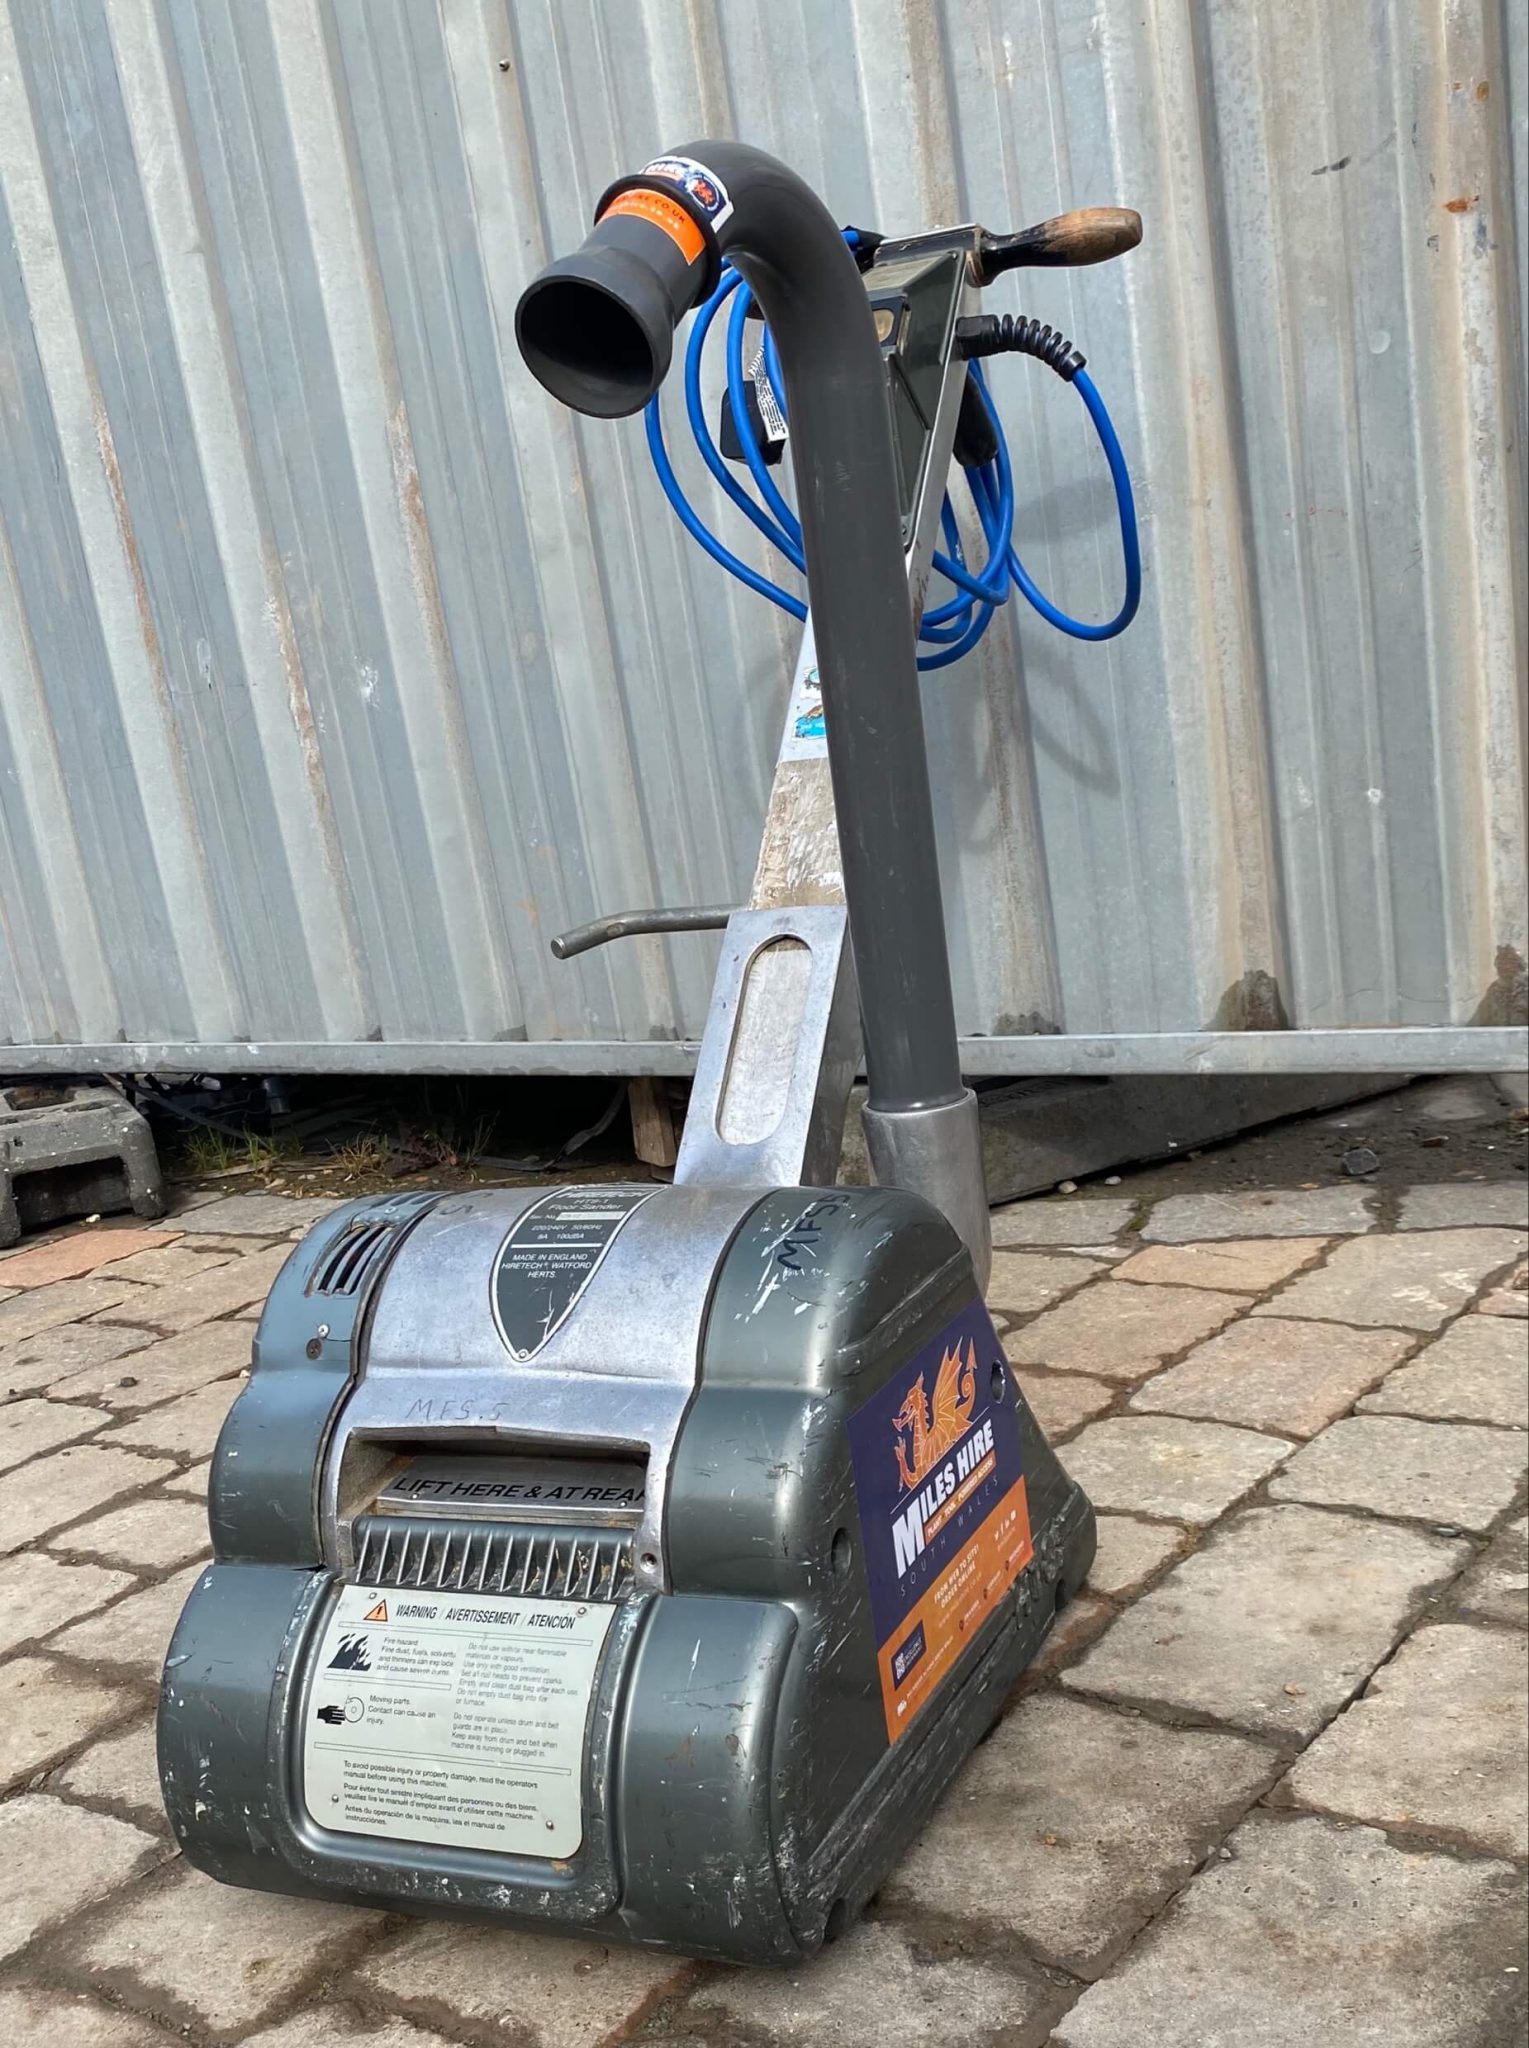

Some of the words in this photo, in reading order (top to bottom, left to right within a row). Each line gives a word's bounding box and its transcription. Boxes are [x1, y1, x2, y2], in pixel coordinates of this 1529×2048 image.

[393, 1478, 452, 1496] LIFT
[452, 1482, 524, 1498] HERE
[523, 1486, 544, 1498] &
[546, 1486, 586, 1500] AT
[892, 1462, 956, 1579] MILES
[956, 1419, 994, 1483] HIRE
[928, 1515, 942, 1537] PLANT
[901, 1537, 946, 1597] SOUTH
[957, 1477, 998, 1528] WALES
[941, 1584, 958, 1609] ORDER
[958, 1561, 976, 1588] ONLINE
[934, 1581, 948, 1604] FROM
[396, 1604, 438, 1619] WARNING
[445, 1607, 520, 1625] AVERTISSEMENT
[392, 1656, 416, 1664] thinners
[503, 1664, 519, 1672] good
[519, 1675, 541, 1683] prevent
[370, 1695, 392, 1704] Moving
[512, 1693, 524, 1701] bag
[368, 1705, 392, 1714] Contact
[454, 1712, 462, 1720] Do
[452, 1732, 466, 1740] Keep
[451, 1741, 474, 1750] machine
[482, 1745, 504, 1754] running
[513, 1747, 537, 1757] plugged
[367, 1773, 387, 1781] before
[389, 1776, 405, 1784] using
[370, 1764, 395, 1772] possible
[397, 1767, 413, 1776] injury
[423, 1770, 448, 1780] property
[450, 1773, 478, 1782] damage,
[507, 1780, 538, 1788] operators
[344, 1782, 358, 1790] Pour
[414, 1792, 446, 1800] impliquant
[461, 1798, 494, 1807] personnes
[345, 1804, 362, 1813] Antes
[487, 1809, 503, 1817] cette
